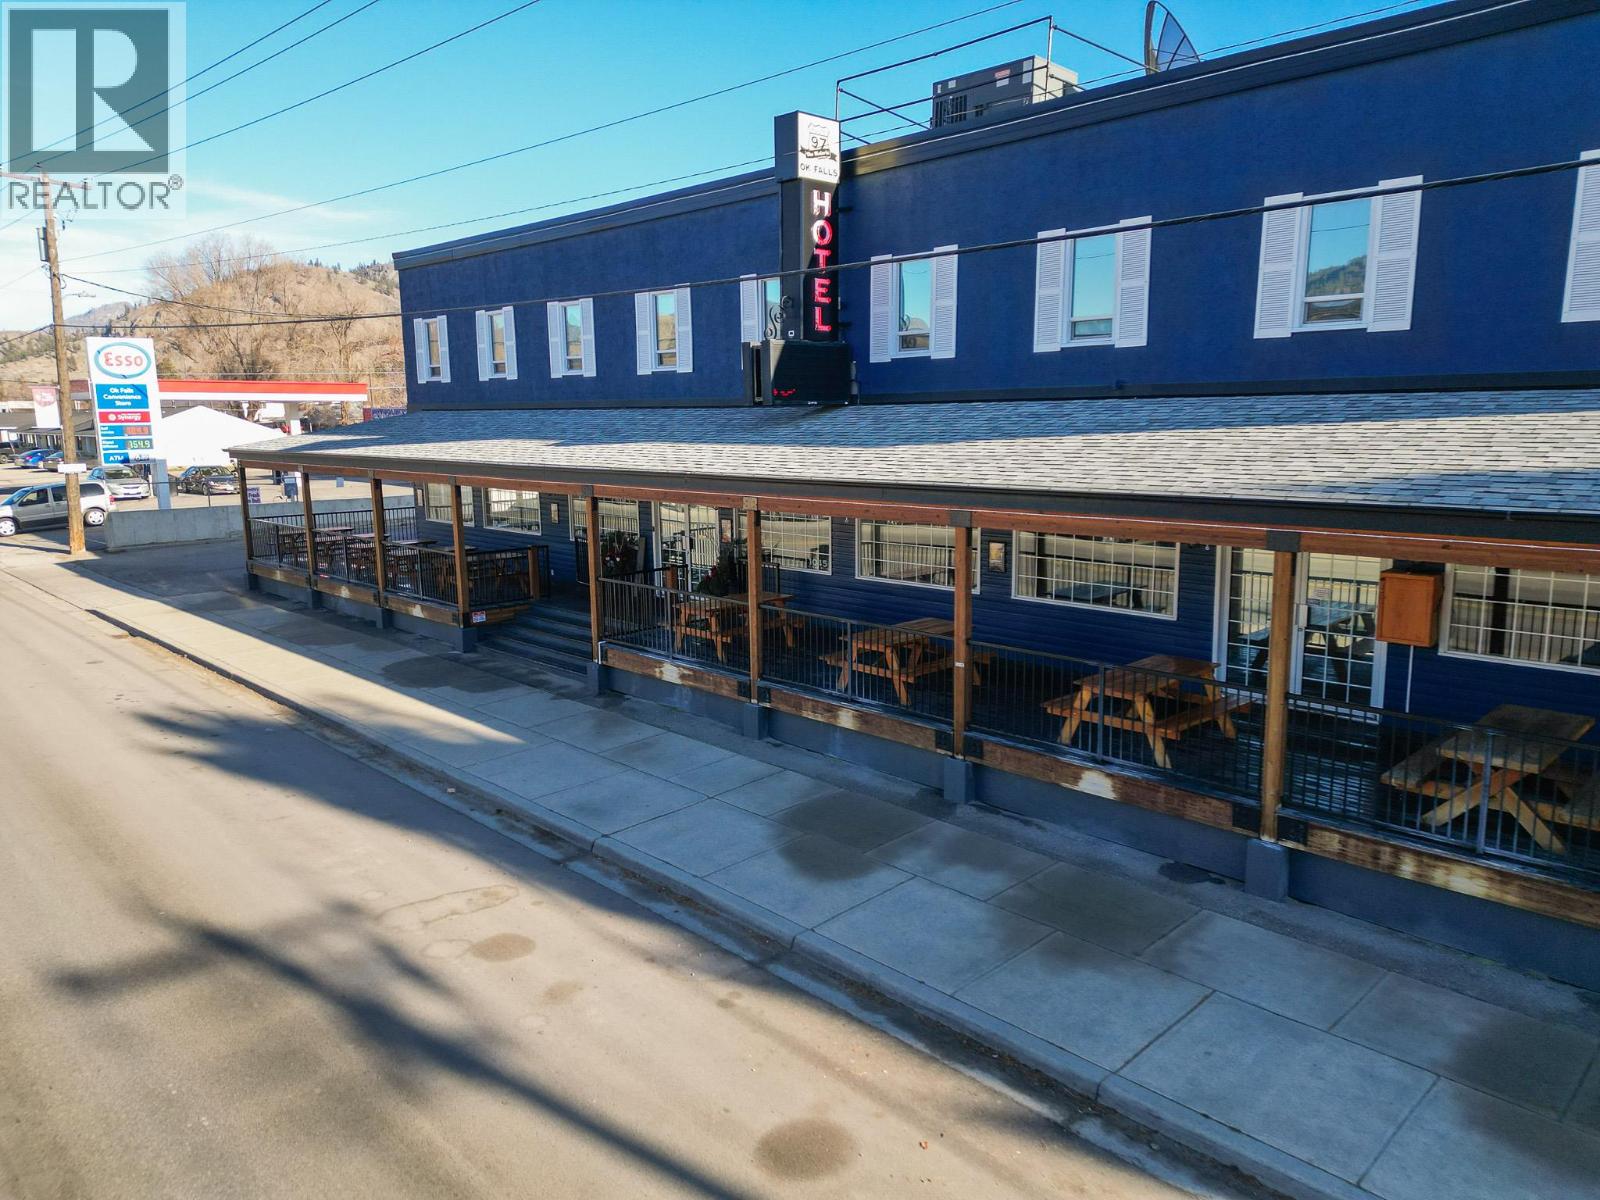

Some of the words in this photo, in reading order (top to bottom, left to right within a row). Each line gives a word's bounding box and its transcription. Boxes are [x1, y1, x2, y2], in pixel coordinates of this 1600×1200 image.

[811, 136, 827, 149] 97
[800, 163, 810, 171] OK
[814, 165, 838, 177] FALLS
[812, 189, 833, 332] HOTEL
[117, 413, 142, 421] Synergy
